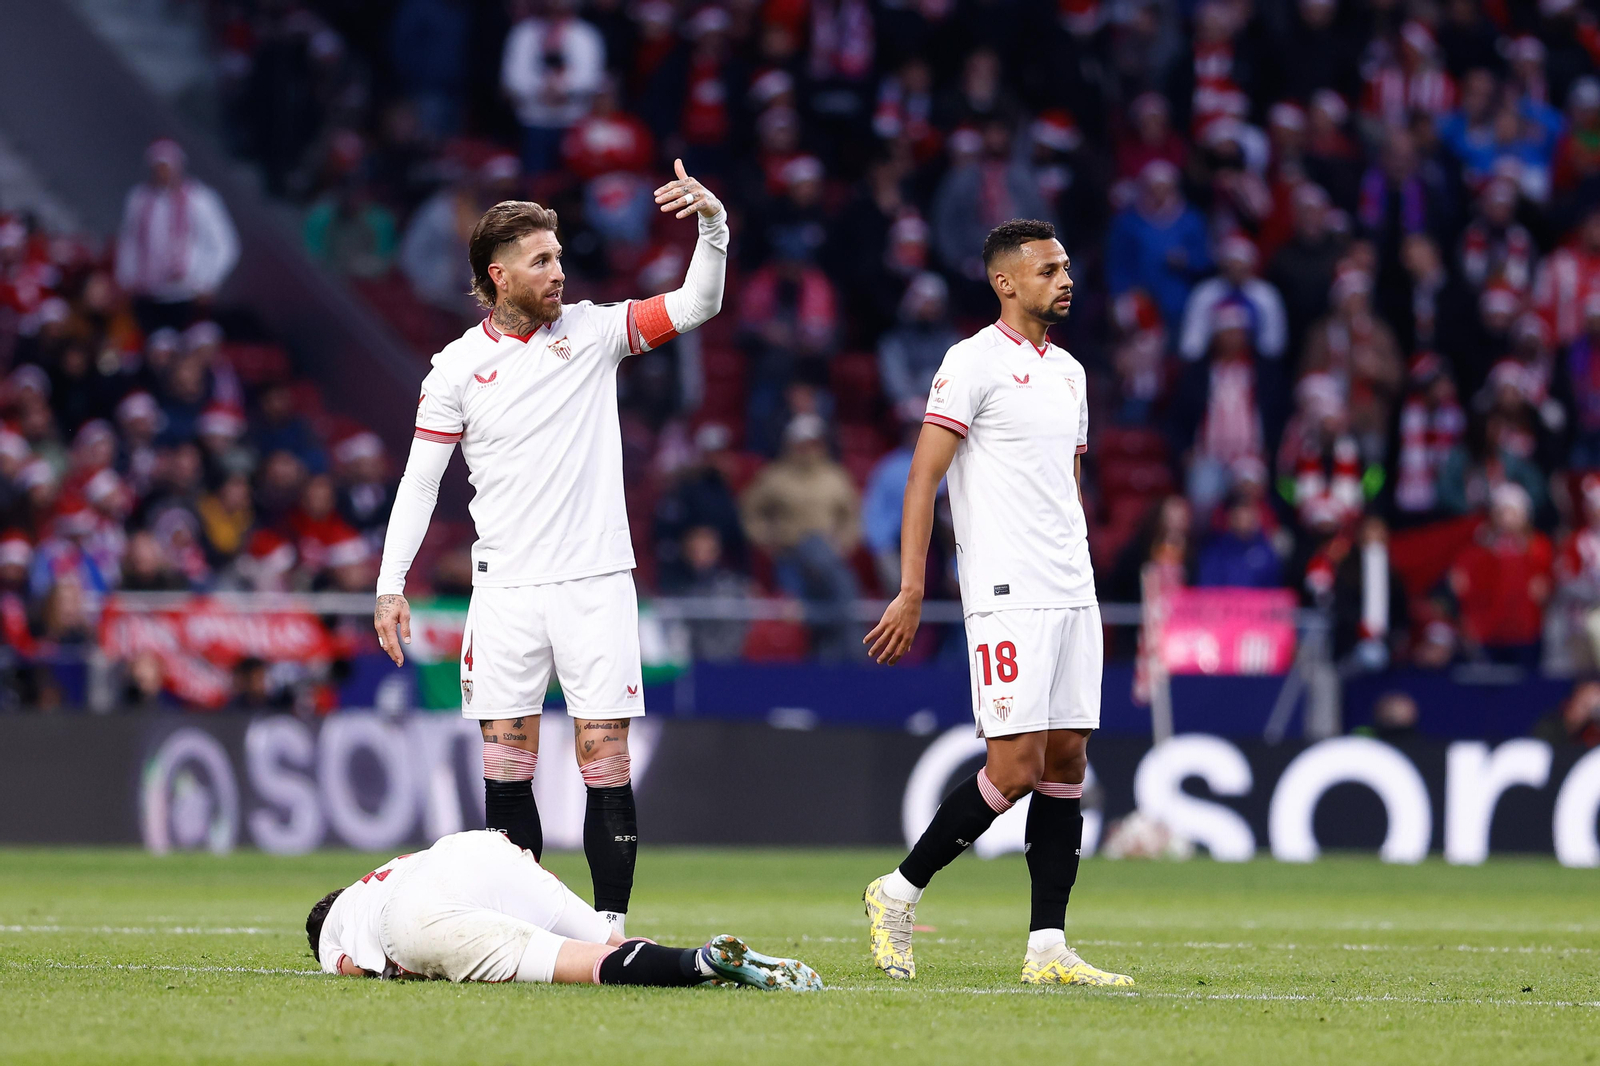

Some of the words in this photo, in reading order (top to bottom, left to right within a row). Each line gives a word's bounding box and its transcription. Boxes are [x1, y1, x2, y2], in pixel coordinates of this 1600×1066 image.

[464, 631, 474, 672] 4
[976, 640, 1019, 686] 18
[1133, 732, 1600, 867] sor
